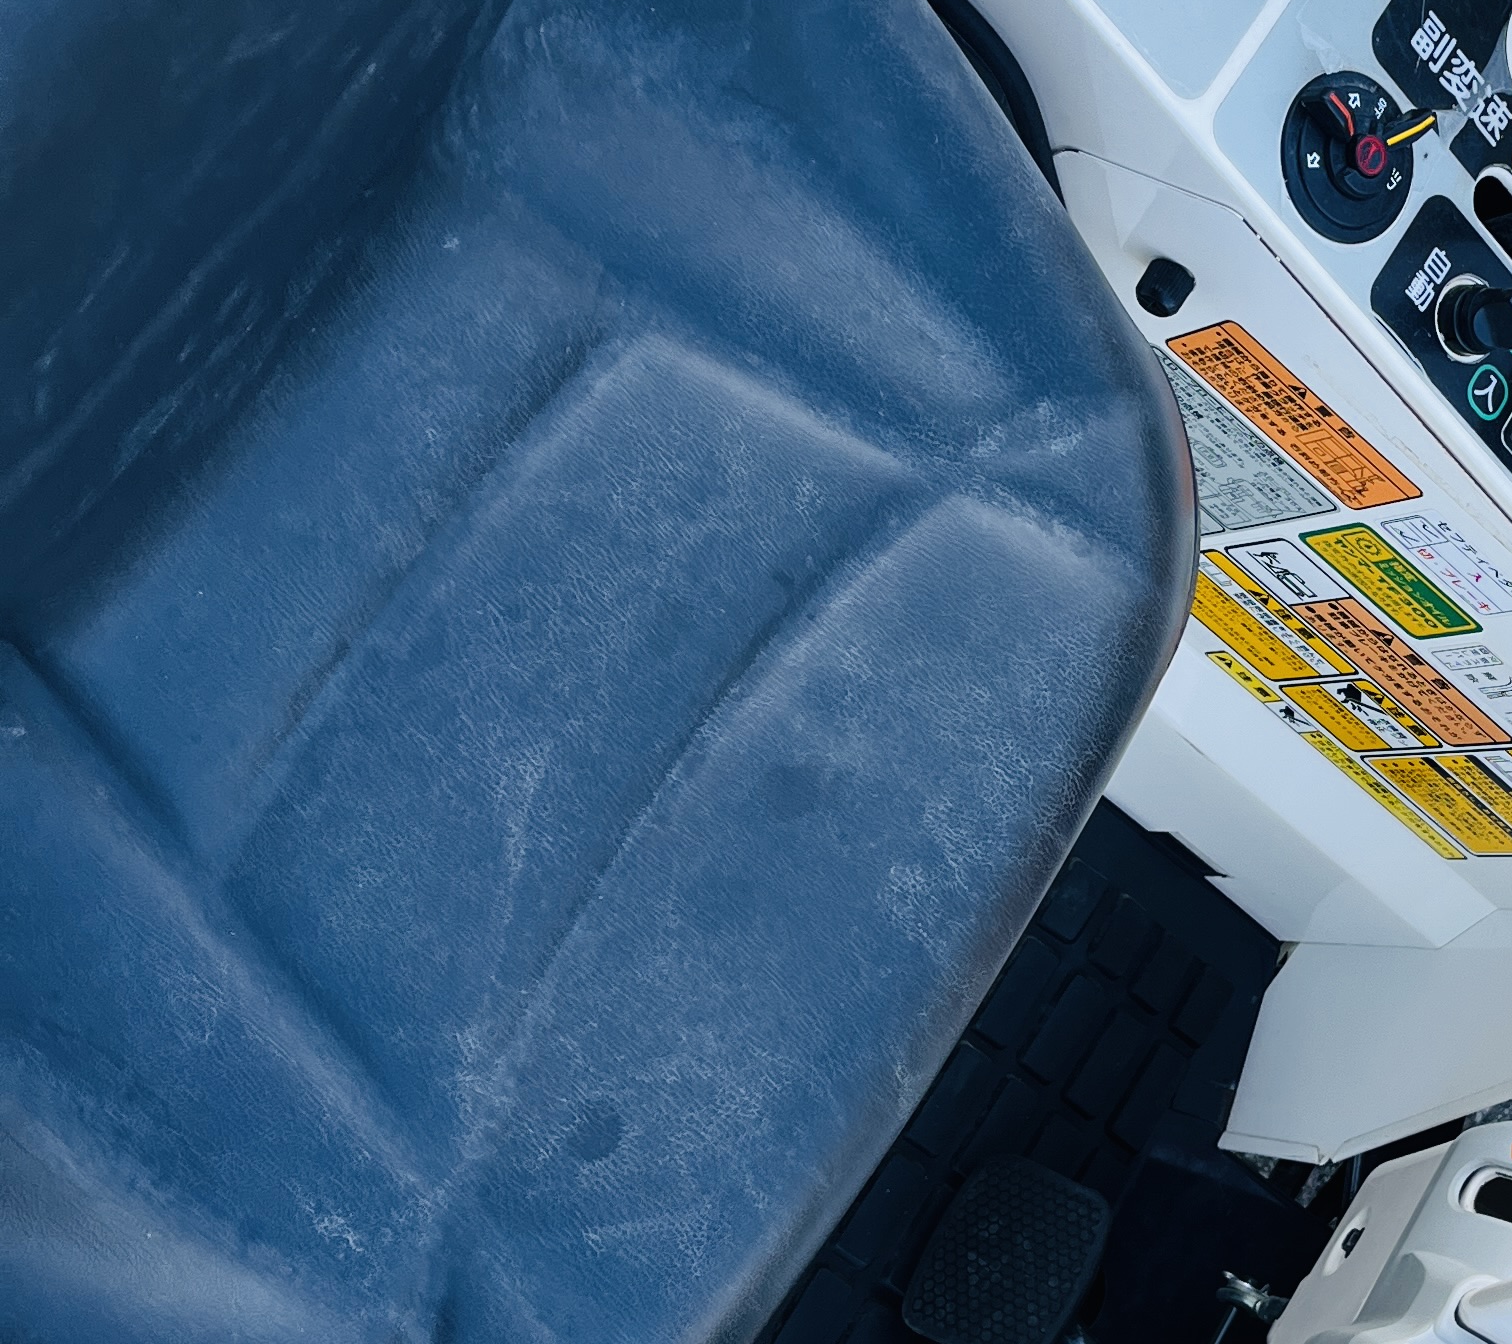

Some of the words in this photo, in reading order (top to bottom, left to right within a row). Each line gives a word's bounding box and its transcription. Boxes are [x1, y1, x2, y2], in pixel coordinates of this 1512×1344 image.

[1374, 97, 1388, 119] OFF
[1404, 246, 1452, 312] 自動
[1473, 374, 1498, 413] 入
